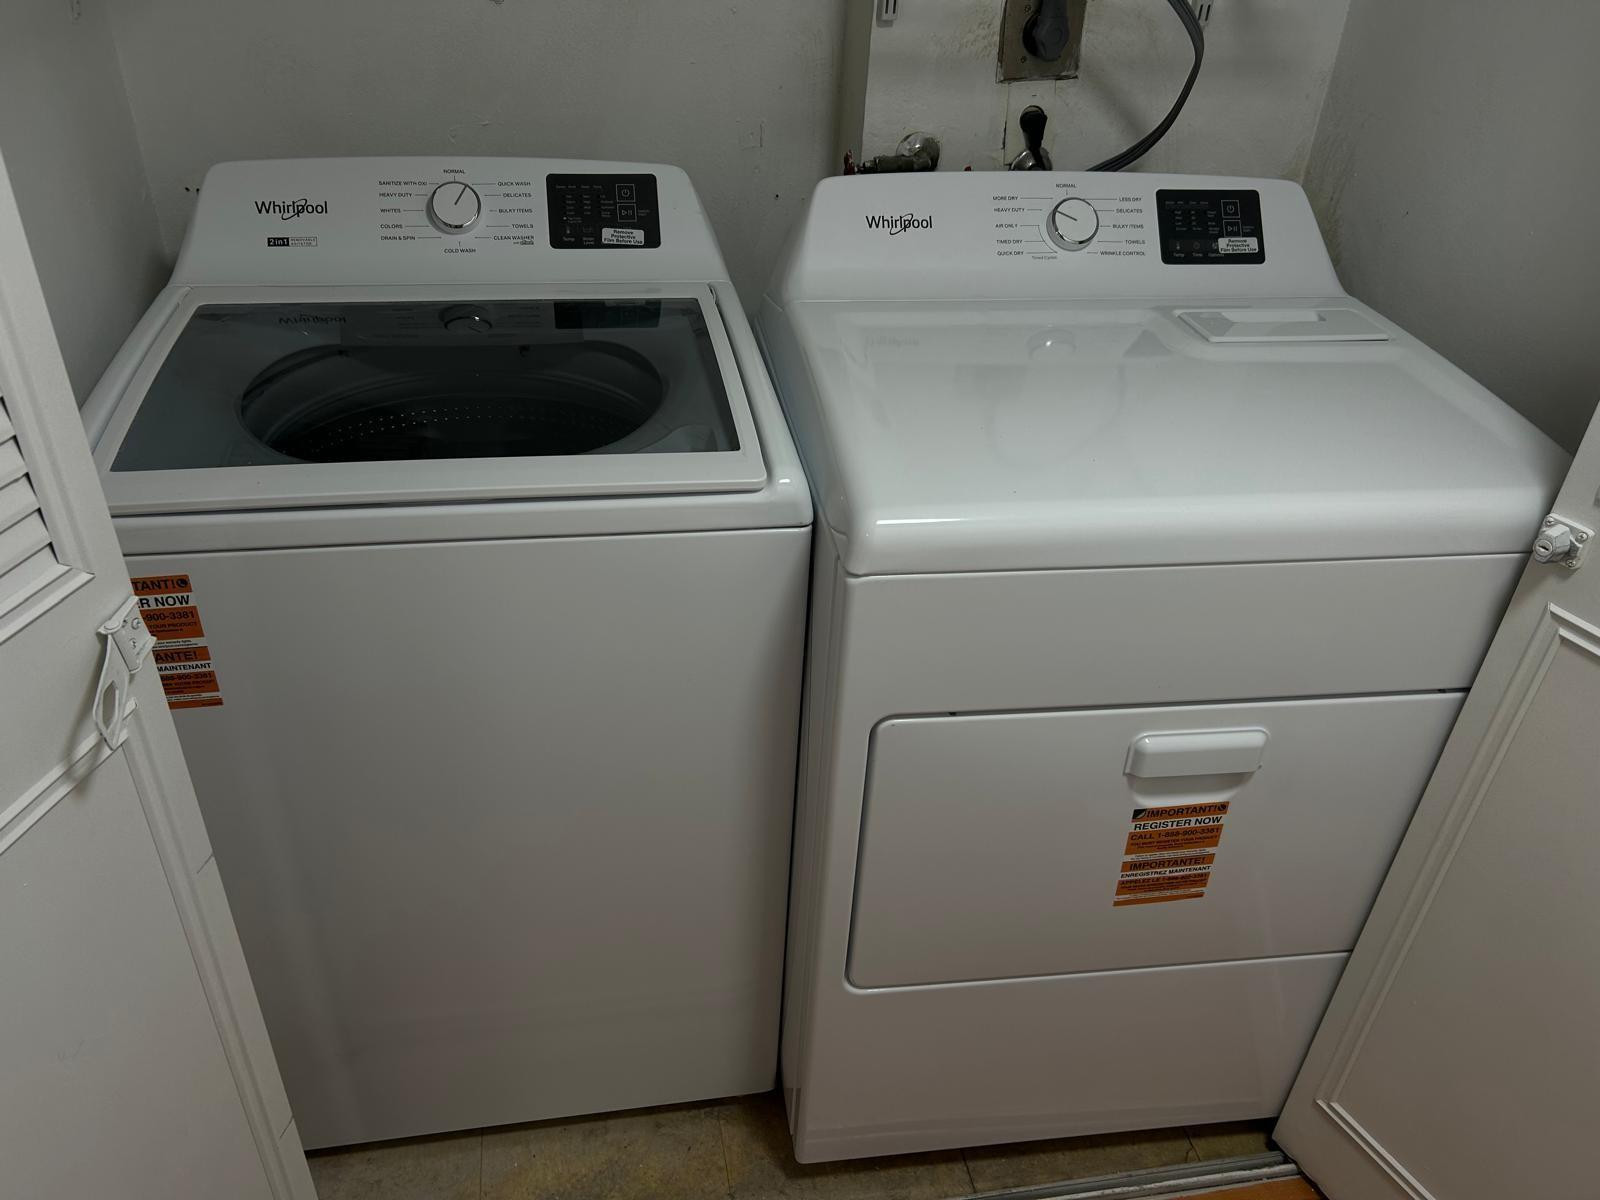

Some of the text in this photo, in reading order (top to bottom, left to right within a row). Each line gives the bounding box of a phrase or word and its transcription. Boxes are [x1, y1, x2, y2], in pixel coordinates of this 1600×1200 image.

[254, 198, 328, 220] Whirlpool
[866, 213, 932, 236] Whirlpool
[132, 580, 176, 591] TANT!
[154, 595, 190, 606] NOW
[143, 611, 194, 622] -900-3381
[156, 650, 198, 662] ANTE!
[157, 662, 212, 672] MAINTENANT
[1146, 804, 1217, 818] IMPORTANT!
[1134, 816, 1222, 830] REGISTER NOW
[1129, 857, 1206, 870] IMPORTANTE!
[1120, 870, 1168, 878] ENREGISTREZ
[1168, 866, 1212, 874] MAINTENANT
